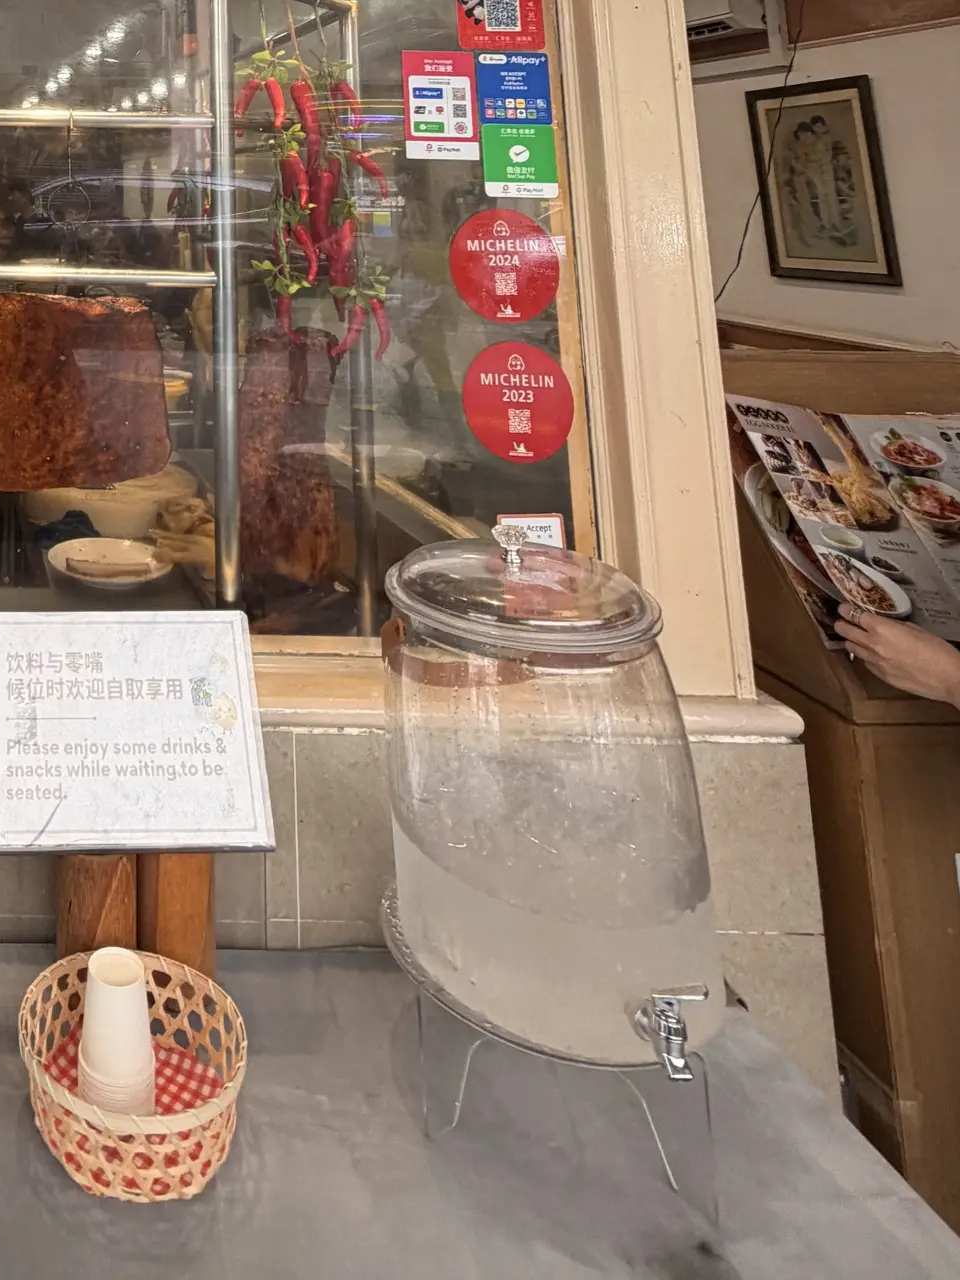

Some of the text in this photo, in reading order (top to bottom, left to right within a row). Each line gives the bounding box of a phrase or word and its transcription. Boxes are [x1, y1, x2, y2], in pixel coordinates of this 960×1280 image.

[467, 239, 539, 252] MICHELIN
[488, 254, 520, 267] 2024
[480, 373, 554, 388] MICHELIN
[502, 389, 534, 403] 2023
[527, 524, 552, 534] Accept
[5, 651, 104, 674] 饮料与零嘴
[5, 677, 183, 701] 候位时欢迎自取享用
[6, 737, 227, 760] Please enjoy some drinks &
[6, 760, 62, 777] snacks
[67, 760, 111, 777] while
[180, 761, 198, 777] to
[202, 760, 224, 777] be
[6, 782, 68, 800] seated.
